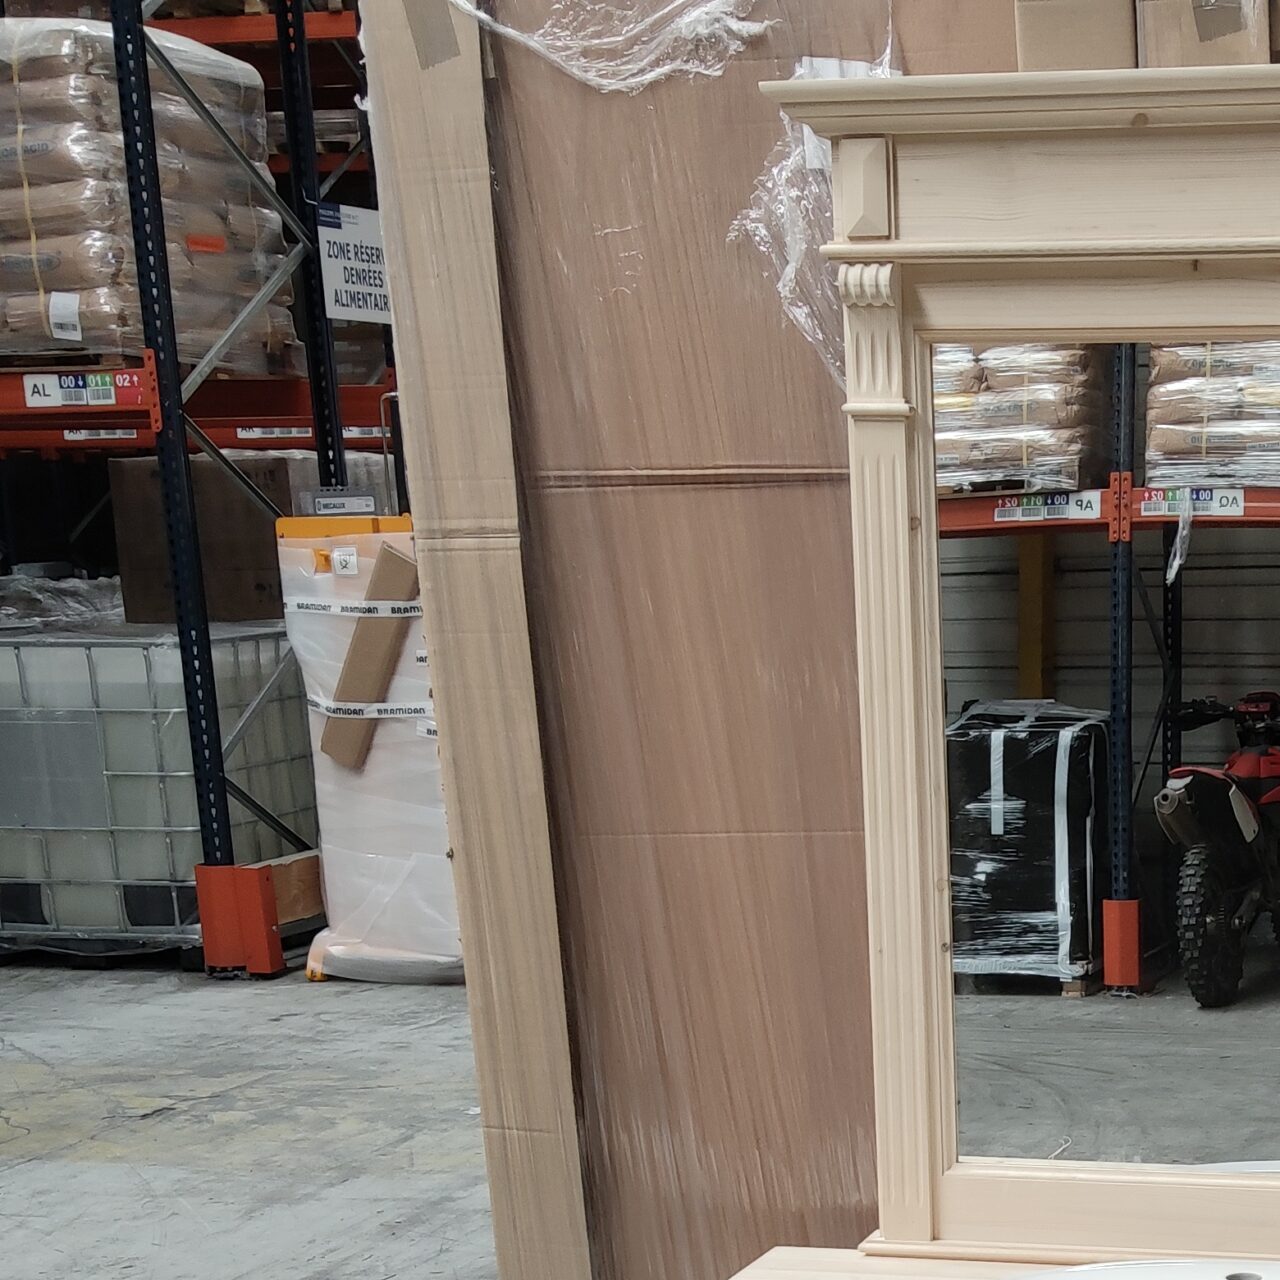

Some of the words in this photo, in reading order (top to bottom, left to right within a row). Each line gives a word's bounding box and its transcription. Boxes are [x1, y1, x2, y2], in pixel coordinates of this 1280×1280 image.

[326, 240, 352, 261] ZONE
[343, 265, 384, 289] DENRÉES
[31, 383, 52, 398] AL
[61, 375, 76, 388] 00
[89, 375, 102, 387] 01
[116, 374, 131, 387] 02
[340, 605, 378, 614] BRAMIDAN
[377, 707, 426, 716] BRAMIDAN
